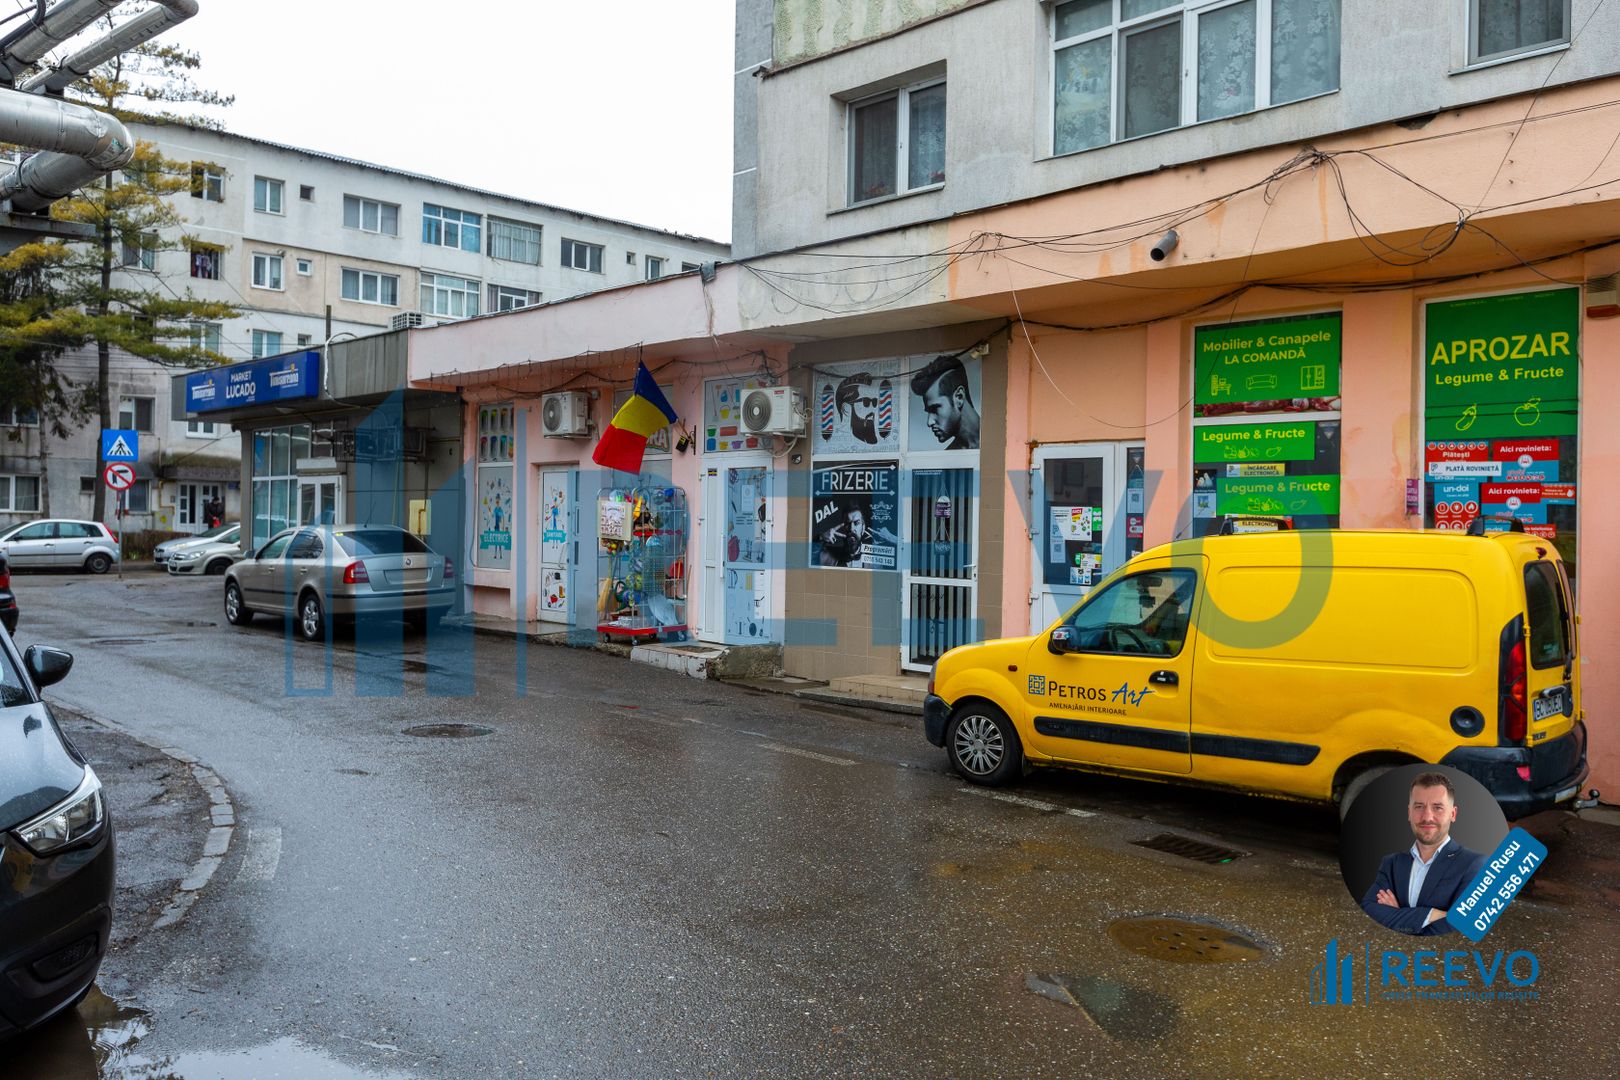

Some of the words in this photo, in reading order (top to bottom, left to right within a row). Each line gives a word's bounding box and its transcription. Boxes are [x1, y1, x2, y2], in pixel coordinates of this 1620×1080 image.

[1203, 338, 1253, 352] Mobilier
[1256, 337, 1265, 347] &
[1269, 331, 1331, 346] Canapele
[1430, 331, 1570, 366] APROZAR
[1224, 354, 1240, 365] LA
[1242, 347, 1306, 363] COMANDĂ
[231, 371, 252, 383] MARKET
[1436, 372, 1494, 387] Legume
[1498, 369, 1509, 381] &
[1514, 366, 1564, 380] Fructe
[226, 382, 256, 399] LUCADO
[1203, 430, 1250, 443] Legume
[1253, 430, 1262, 440] &
[1265, 428, 1306, 439] Fructe
[1445, 463, 1465, 472] PLATĂ
[822, 471, 888, 490] FRIZERIE
[1225, 483, 1273, 495] Legume
[1277, 482, 1286, 492] &
[1289, 482, 1331, 492] Fructe
[1443, 484, 1470, 493] un-doi
[814, 501, 839, 524] DAL
[484, 533, 509, 543] ELECTRICE
[1048, 681, 1107, 701] PETROS
[1111, 682, 1155, 707] Art
[1049, 702, 1086, 711] AMENAJĂRI
[1087, 706, 1127, 716] INTERIOARE
